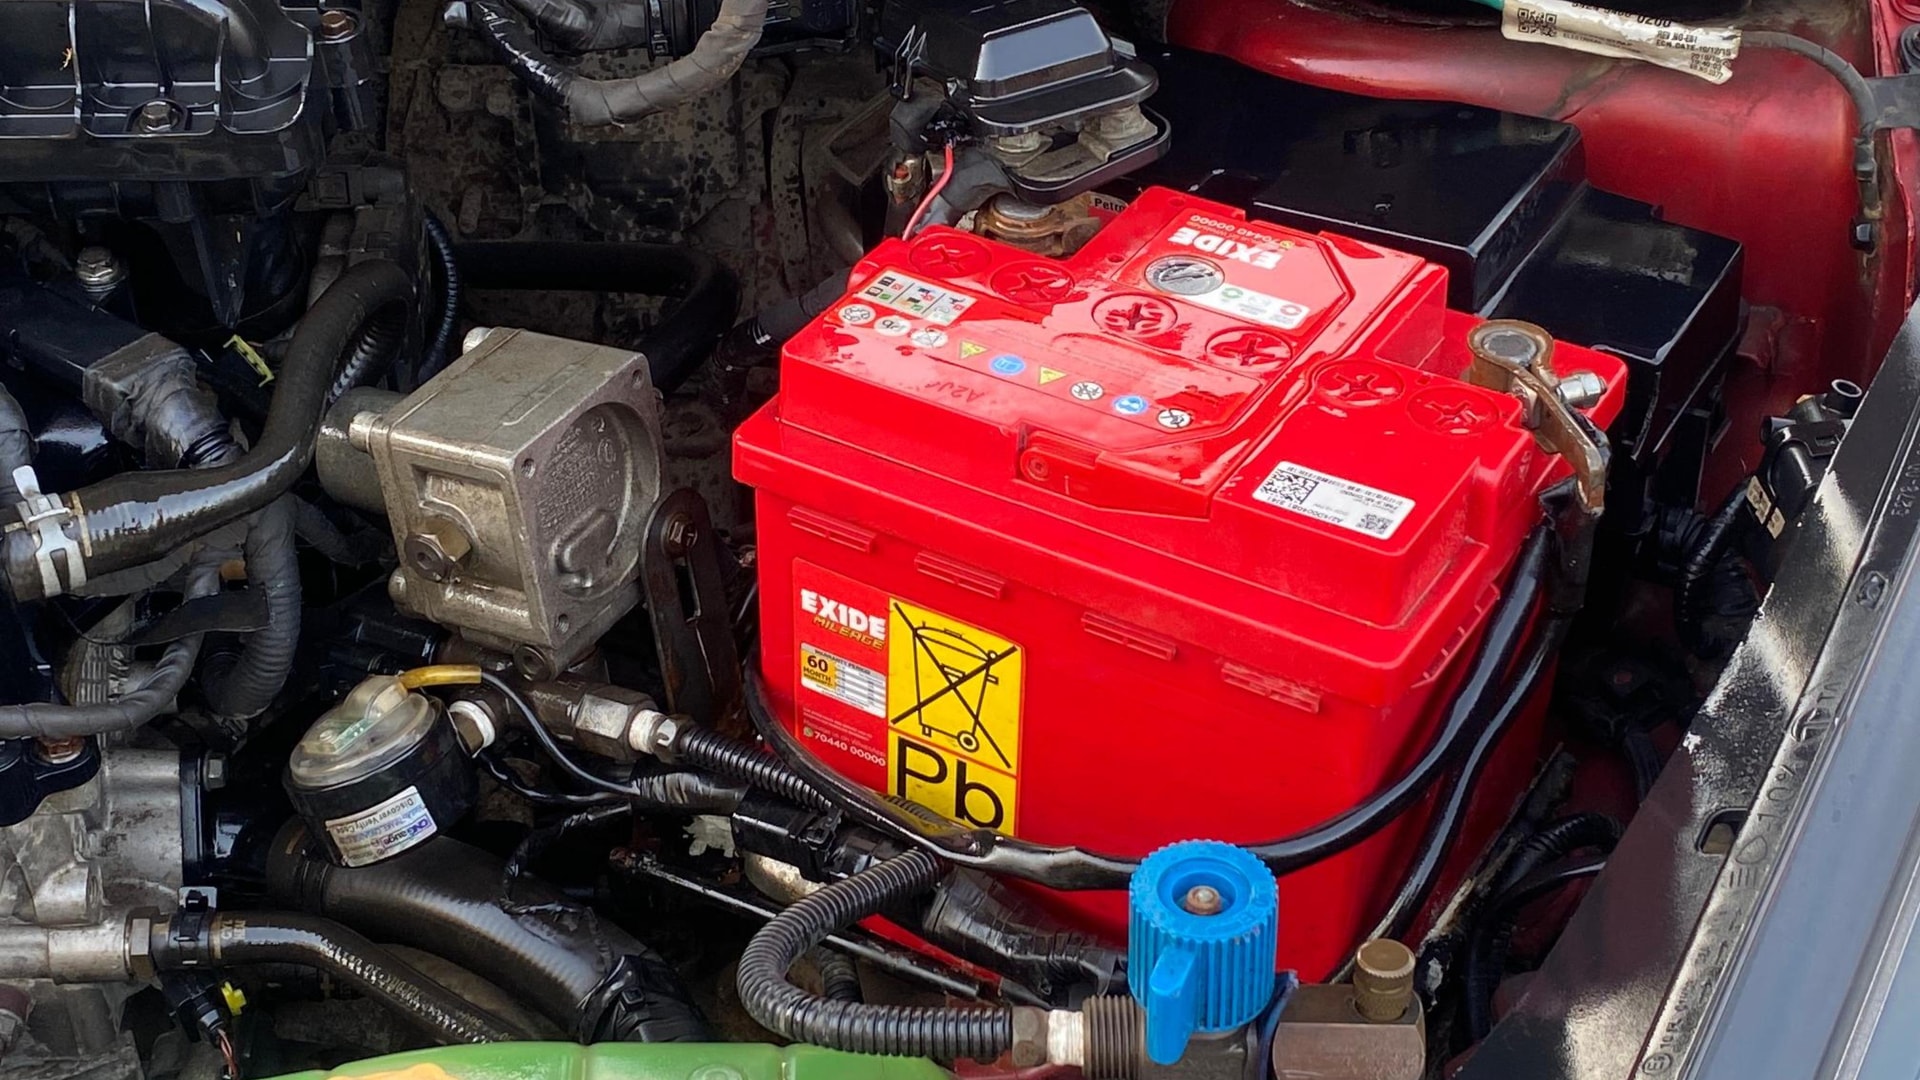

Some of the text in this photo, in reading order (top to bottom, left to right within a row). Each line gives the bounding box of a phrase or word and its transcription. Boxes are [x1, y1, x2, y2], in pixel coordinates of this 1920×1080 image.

[1168, 226, 1283, 270] EXIDE
[801, 588, 886, 642] EXIDE
[813, 615, 884, 650] MILEAGE
[803, 666, 831, 683] MONTH
[807, 654, 829, 673] 60
[814, 730, 887, 767] 70440 00000
[896, 735, 1004, 831] Pb
